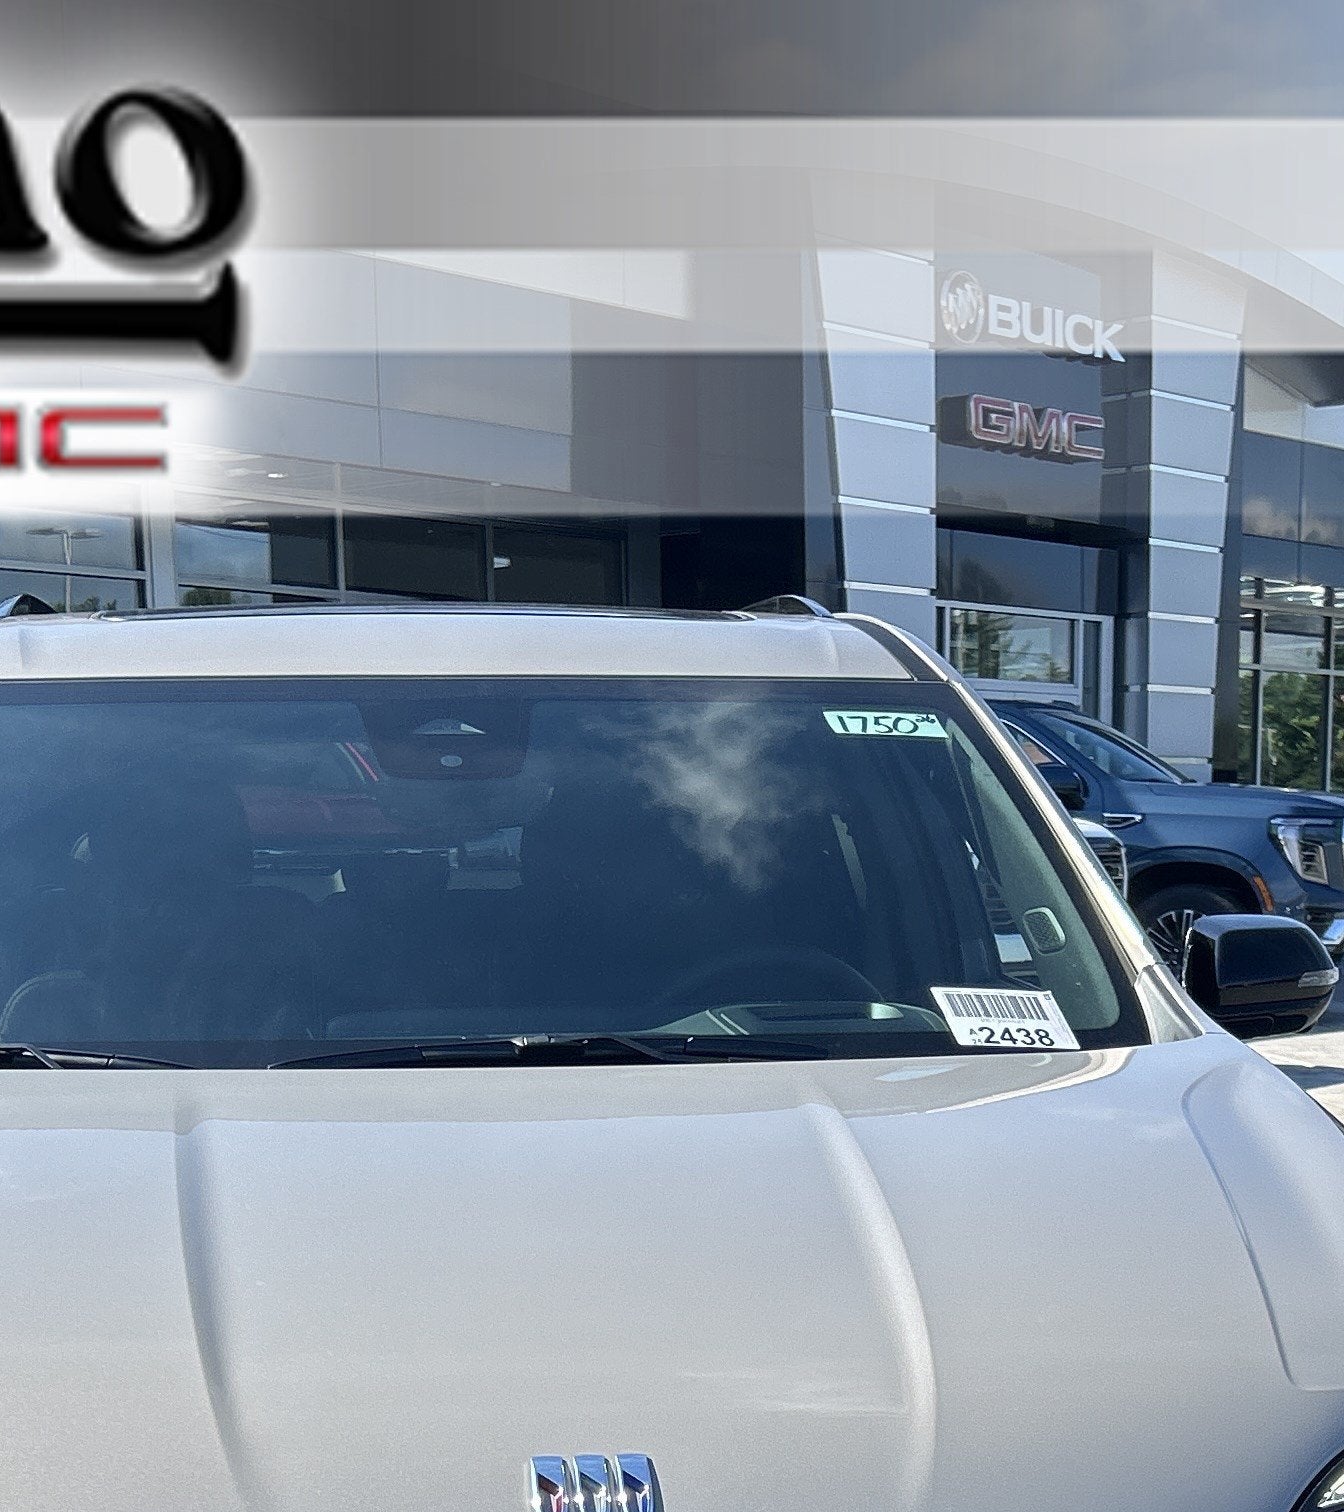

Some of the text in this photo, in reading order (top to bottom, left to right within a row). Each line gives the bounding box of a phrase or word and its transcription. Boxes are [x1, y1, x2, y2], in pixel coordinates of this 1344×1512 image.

[987, 294, 1126, 363] BUICK
[971, 394, 1106, 460] GMC
[836, 715, 919, 734] 1750
[978, 1026, 1055, 1047] 2438
